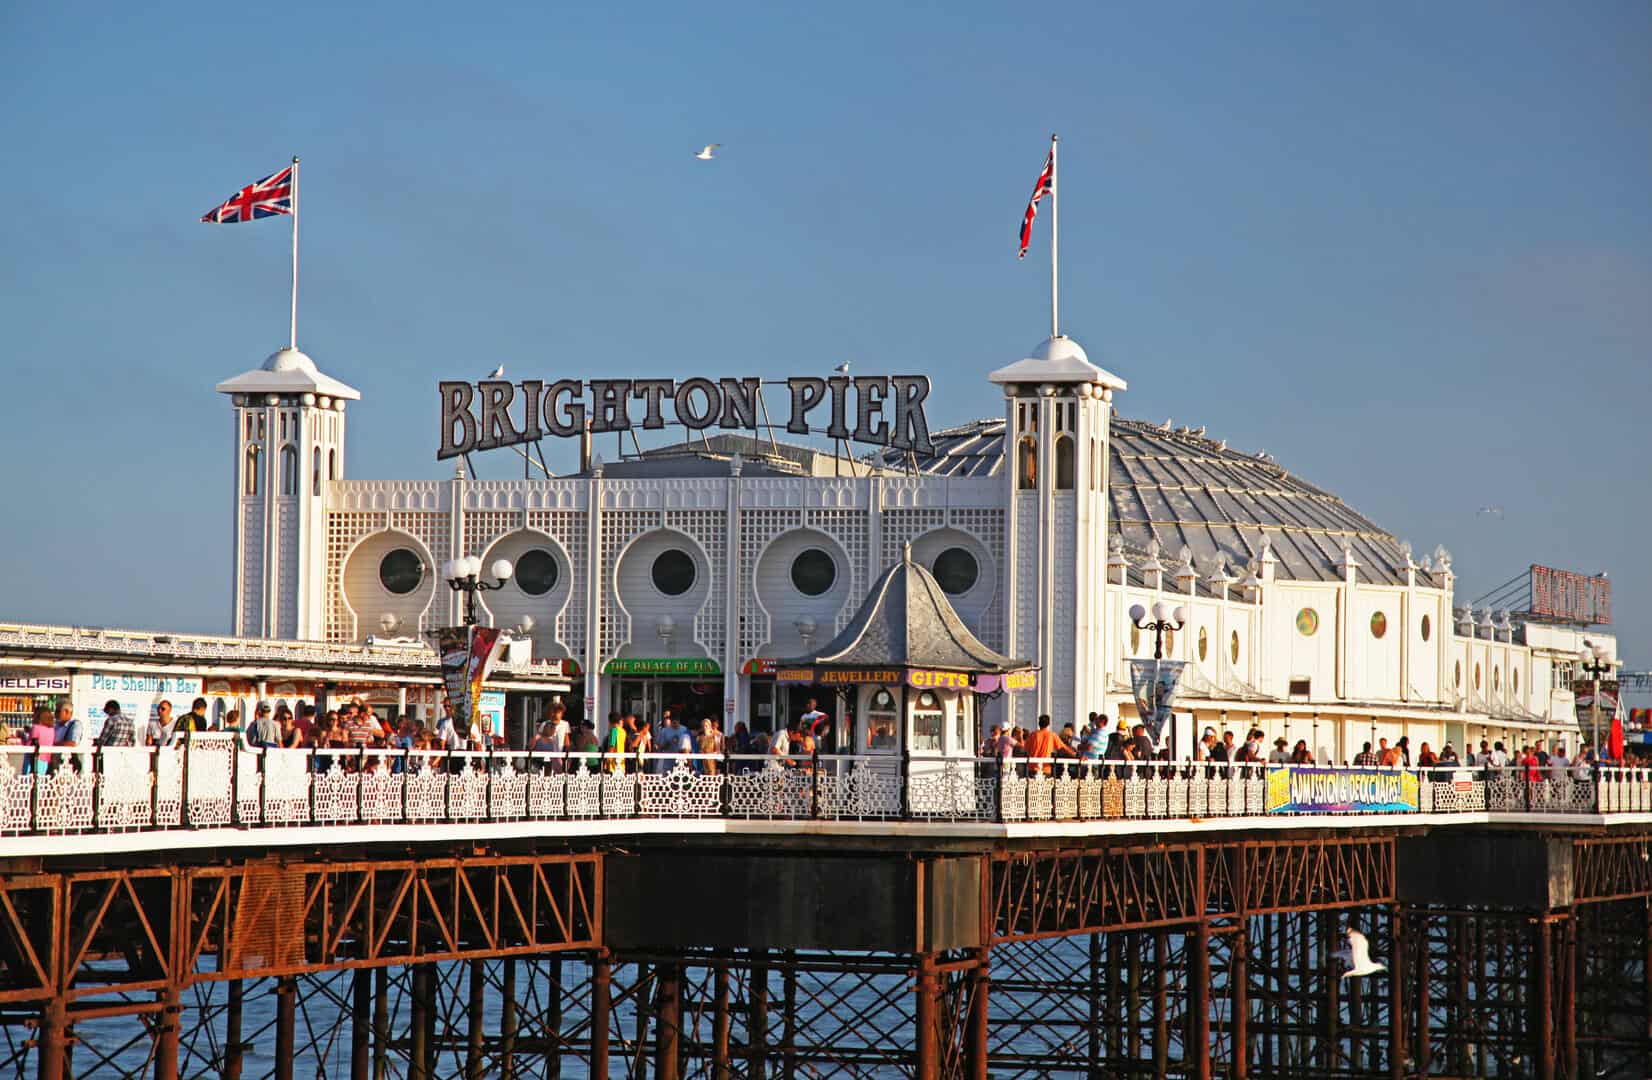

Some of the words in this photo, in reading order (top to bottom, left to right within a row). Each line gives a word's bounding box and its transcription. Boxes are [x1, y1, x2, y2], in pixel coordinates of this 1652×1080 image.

[437, 378, 760, 461] BRIGHTON
[787, 375, 935, 457] PIER
[611, 661, 629, 672] THE
[634, 661, 672, 672] PALACE
[676, 661, 689, 672] OF
[92, 672, 117, 690] Pier
[121, 674, 173, 693] Shellfish
[176, 677, 197, 694] Bar
[821, 671, 900, 682] JEWELLERY
[911, 671, 969, 687] GIFTS
